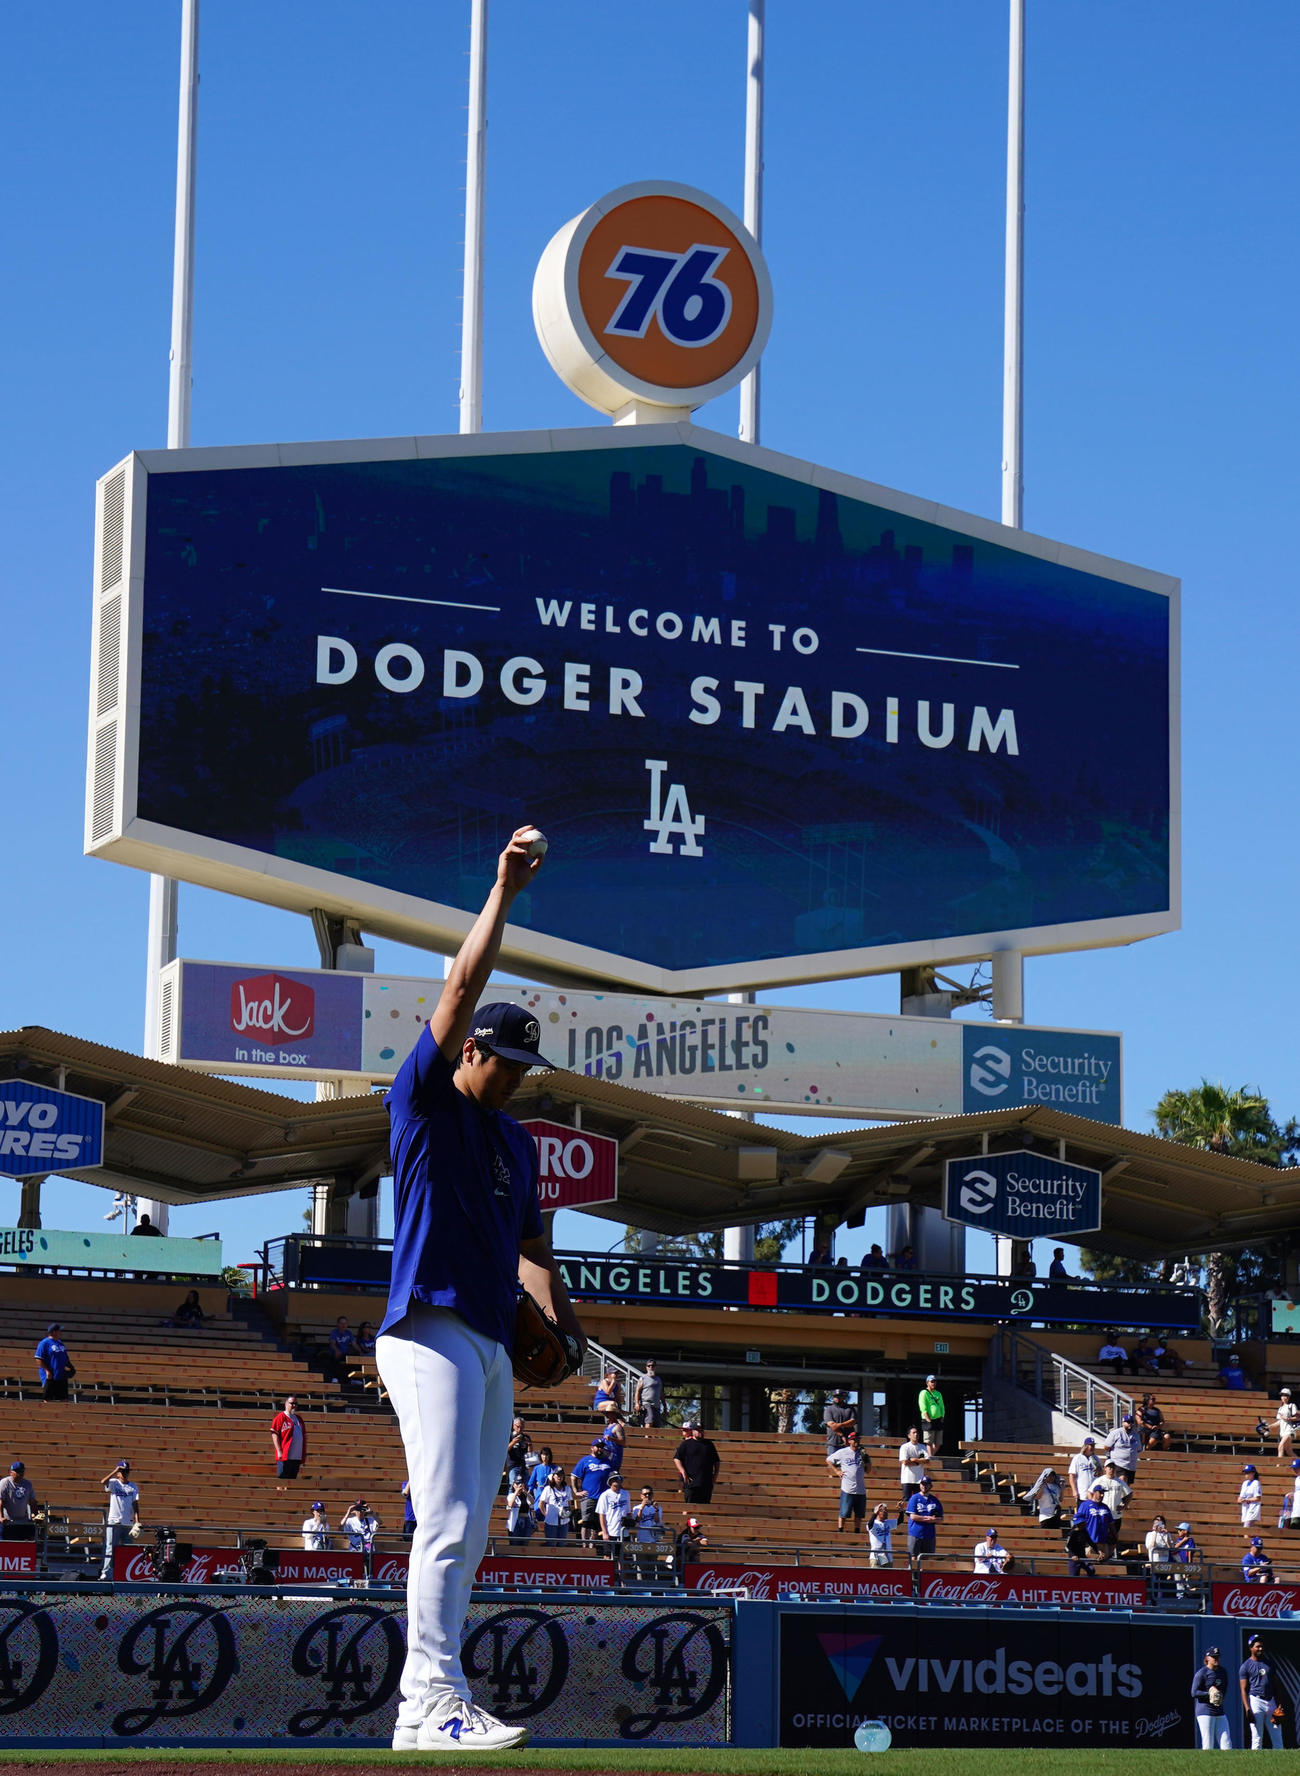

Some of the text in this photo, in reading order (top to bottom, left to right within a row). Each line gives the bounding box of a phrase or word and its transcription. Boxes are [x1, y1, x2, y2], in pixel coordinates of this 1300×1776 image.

[603, 243, 733, 348] 76
[536, 597, 820, 655] WELCOME TO
[316, 635, 1020, 756] DODGER STADIUM
[644, 759, 705, 857] LA
[233, 982, 311, 1036] Jack
[235, 1048, 306, 1065] in the box
[568, 1015, 769, 1081] LOS ANGELES
[1021, 1048, 1112, 1081] Security
[1023, 1076, 1099, 1104] Benefit
[0, 1101, 58, 1129] YO
[533, 1136, 594, 1179] RO
[537, 1182, 560, 1200] JU
[1006, 1172, 1087, 1201] Security
[1007, 1196, 1077, 1221] Benefit
[559, 1265, 713, 1296] ANGELES
[812, 1278, 975, 1311] DODGERS
[303, 1567, 353, 1579] MAGIC
[482, 1571, 610, 1587] HIT EVERY TIME
[778, 1581, 820, 1594] HOME
[825, 1582, 853, 1595] RUN
[858, 1583, 903, 1596] MAGIC
[1007, 1589, 1018, 1601] A
[1022, 1590, 1048, 1602] HIT
[1052, 1591, 1101, 1605] EVERY
[1104, 1592, 1142, 1606] TIME
[944, 1716, 1064, 1733] MARKETPLACE
[1071, 1719, 1093, 1734] OF
[1099, 1720, 1130, 1735] THE
